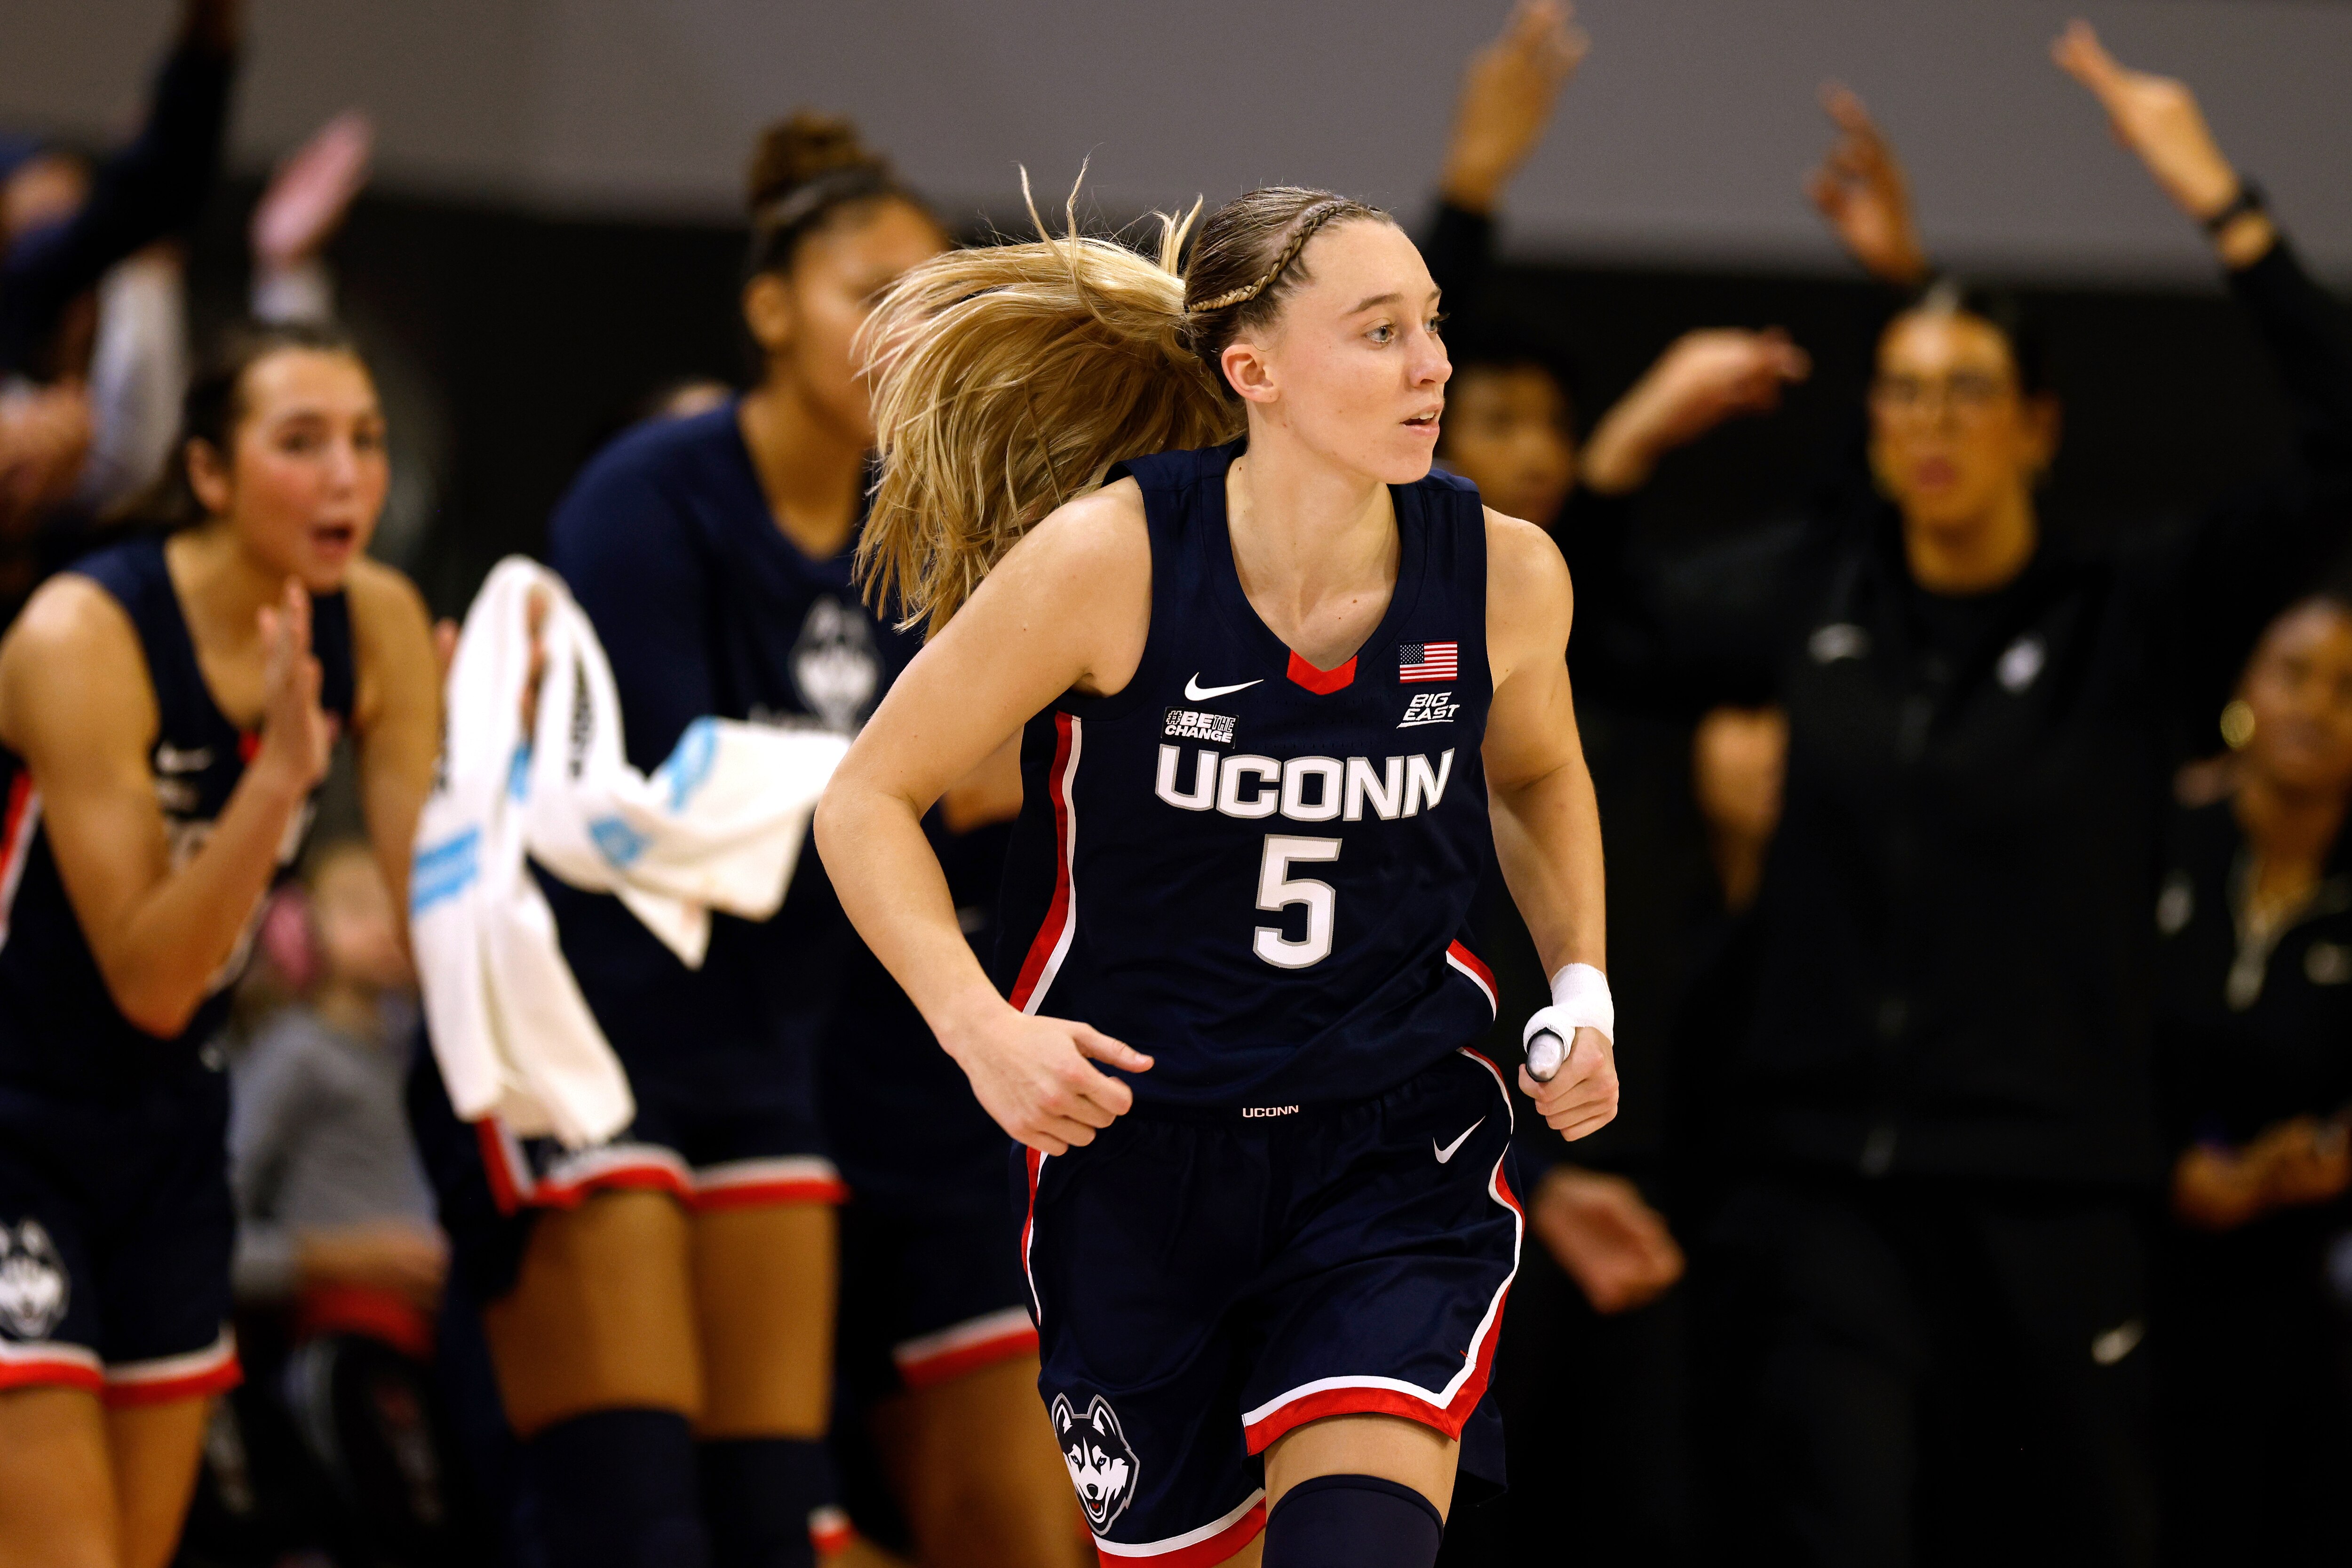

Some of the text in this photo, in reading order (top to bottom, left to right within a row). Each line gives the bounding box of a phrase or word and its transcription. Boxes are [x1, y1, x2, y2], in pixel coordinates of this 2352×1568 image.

[1409, 691, 1452, 708] BIG
[1402, 704, 1460, 721] EAST
[1165, 724, 1233, 743] CHANGE
[1155, 744, 1454, 821] UCONN
[1252, 834, 1343, 969] 5
[1242, 1105, 1299, 1118] UCONN
